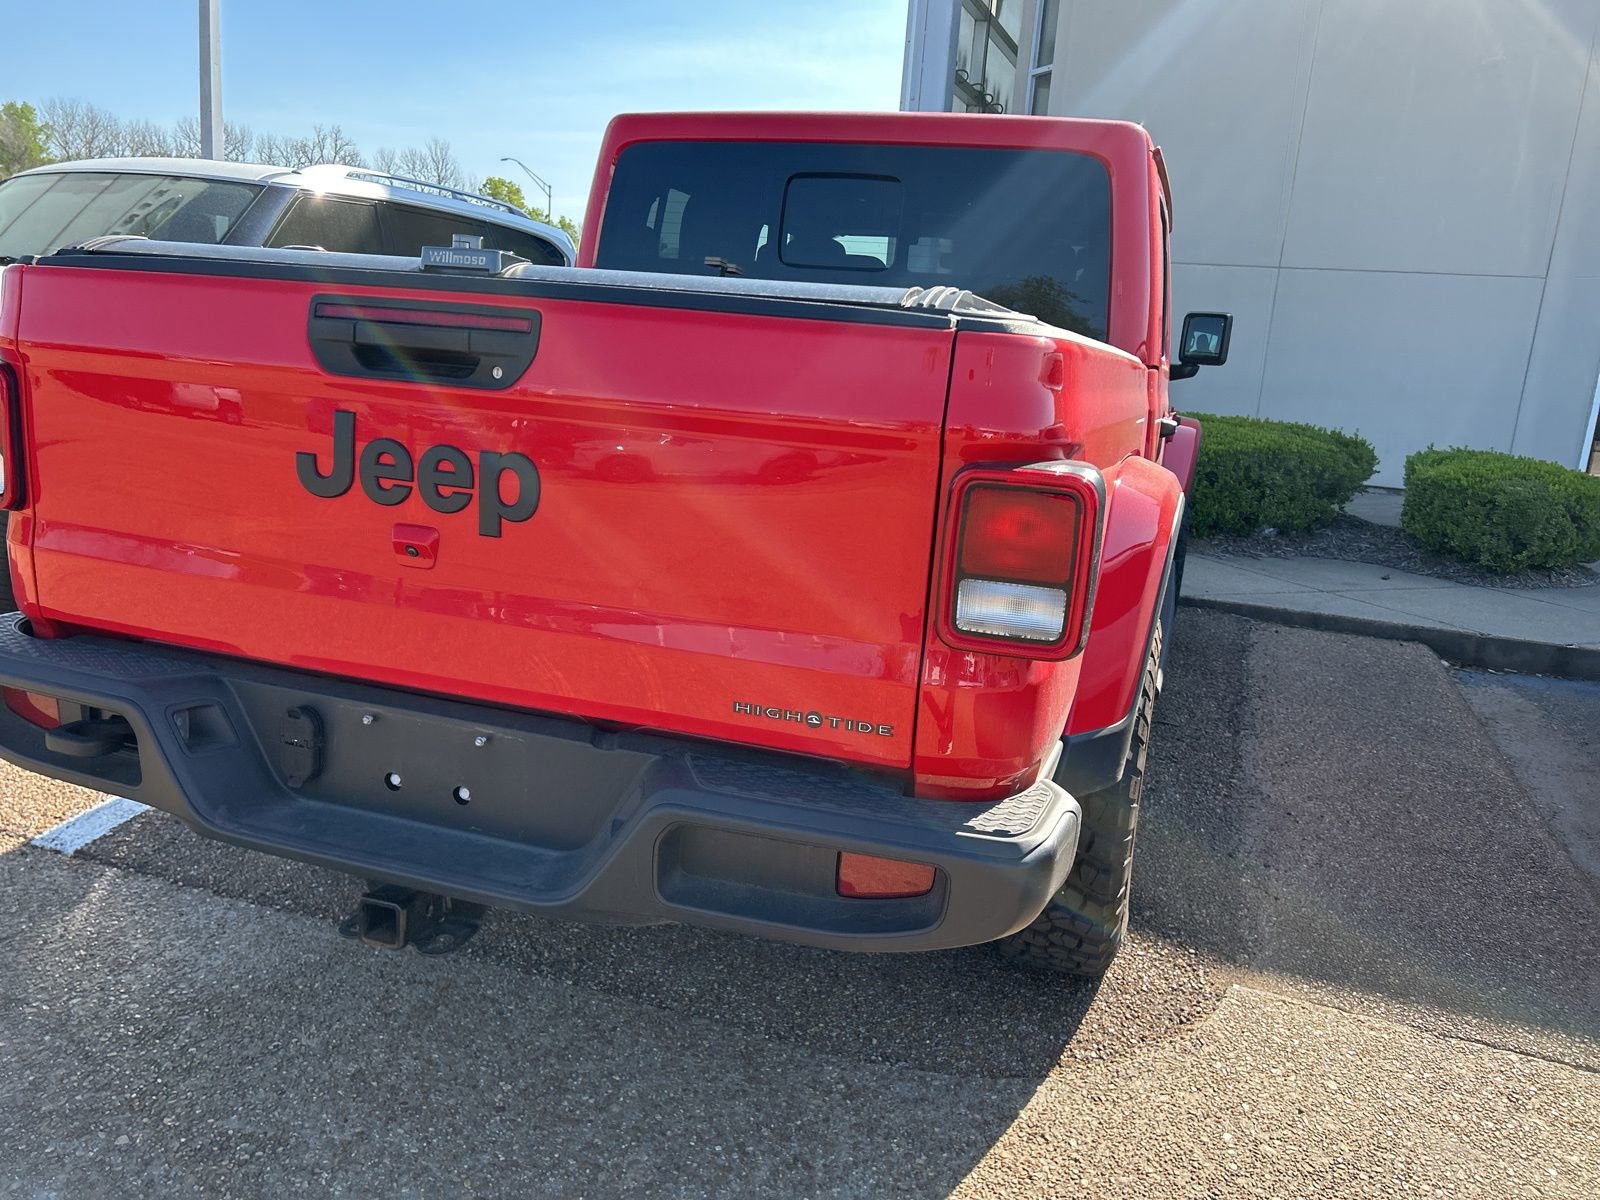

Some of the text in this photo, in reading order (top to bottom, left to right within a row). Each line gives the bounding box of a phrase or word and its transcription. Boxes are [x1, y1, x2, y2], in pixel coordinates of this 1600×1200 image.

[296, 409, 541, 538] Jeep
[733, 701, 894, 737] HIGH TIDE
